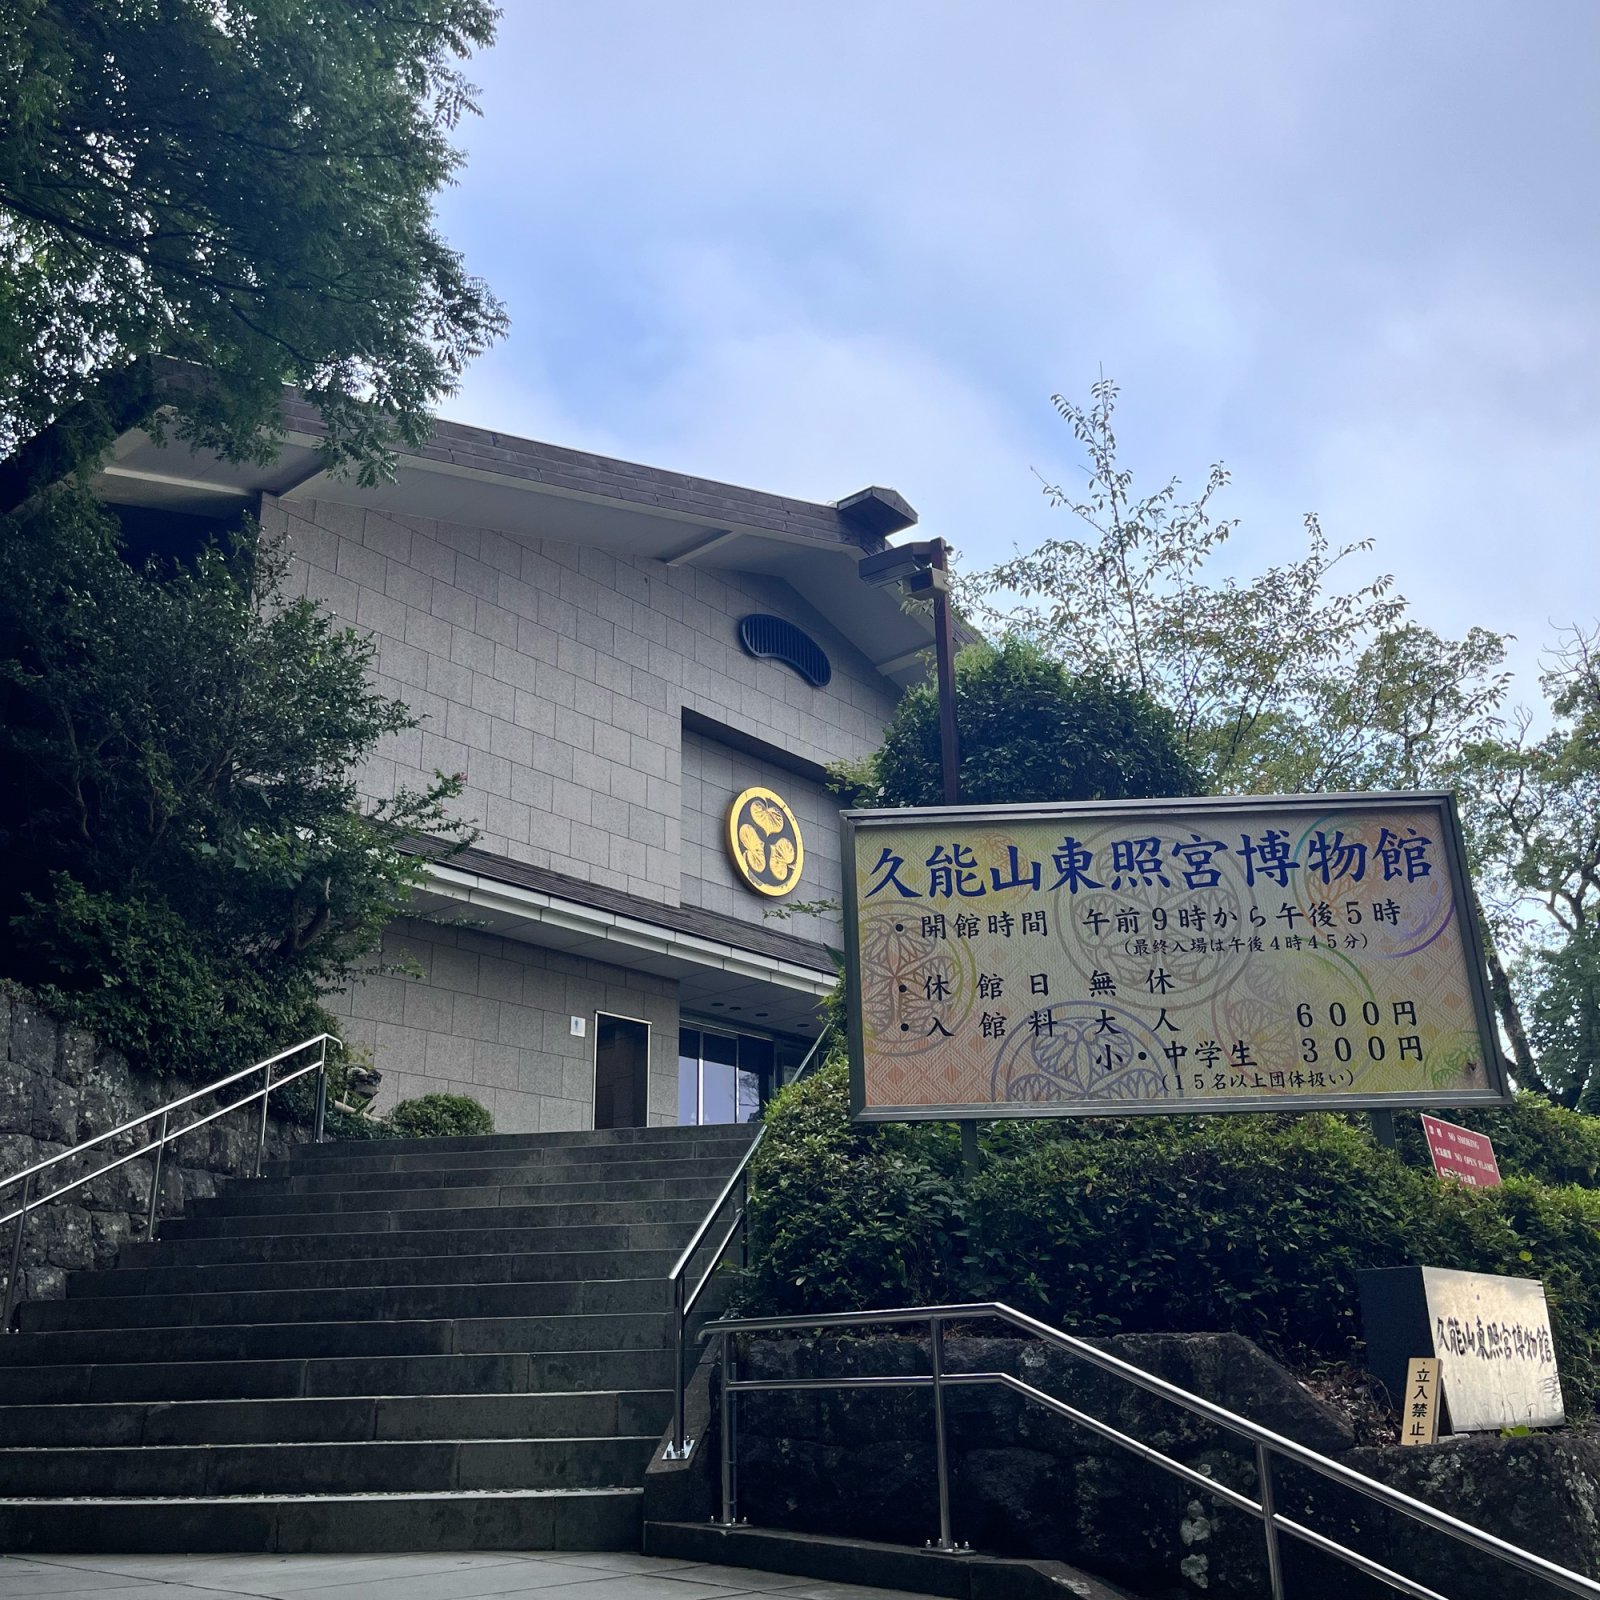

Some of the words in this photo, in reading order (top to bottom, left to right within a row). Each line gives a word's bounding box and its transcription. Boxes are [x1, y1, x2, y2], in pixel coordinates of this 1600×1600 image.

[865, 828, 1433, 898] 久能山東照宮博物館
[921, 910, 1048, 939] 開館時間
[1083, 899, 1400, 934] 午前9時から午後5時
[1125, 934, 1368, 955] (最終入場は午後4時45分)
[923, 973, 1049, 1000] 休館日
[1088, 968, 1175, 998] 無休
[926, 1010, 1058, 1039] 入館料
[1095, 1008, 1181, 1035] 大人
[1296, 1001, 1417, 1028] 600円
[1096, 1040, 1257, 1070] 小・中学生
[1302, 1035, 1423, 1063] 300円
[1163, 1069, 1354, 1091] (15名以上団体扱い)
[1437, 1315, 1552, 1363] 久能山東照宮博物館
[1409, 1368, 1430, 1436] 立入禁止
